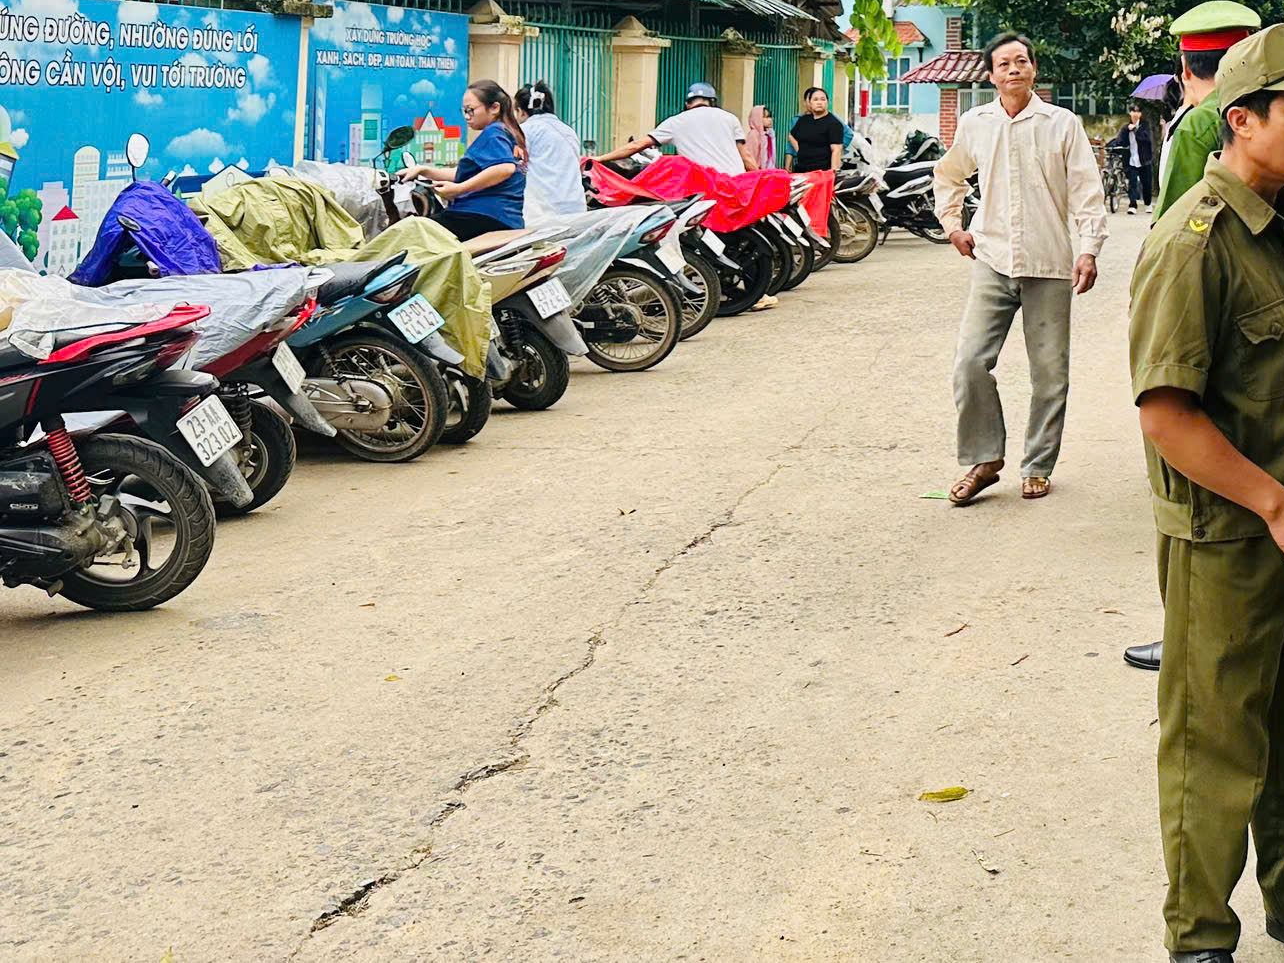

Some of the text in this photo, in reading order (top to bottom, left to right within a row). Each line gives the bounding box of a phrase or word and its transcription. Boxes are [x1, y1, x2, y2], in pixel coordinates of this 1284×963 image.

[44, 12, 115, 50] ĐƯỜNG,
[119, 18, 189, 50] NHƯỜNG
[192, 23, 234, 52] ĐÚNG
[236, 23, 259, 53] LỐI
[45, 48, 86, 86] CẦN
[90, 56, 126, 93] VỘI,
[131, 63, 157, 87] VUI
[161, 58, 185, 87] TỚI
[189, 60, 247, 88] TRƯỜNG
[197, 421, 237, 461] 323.02
